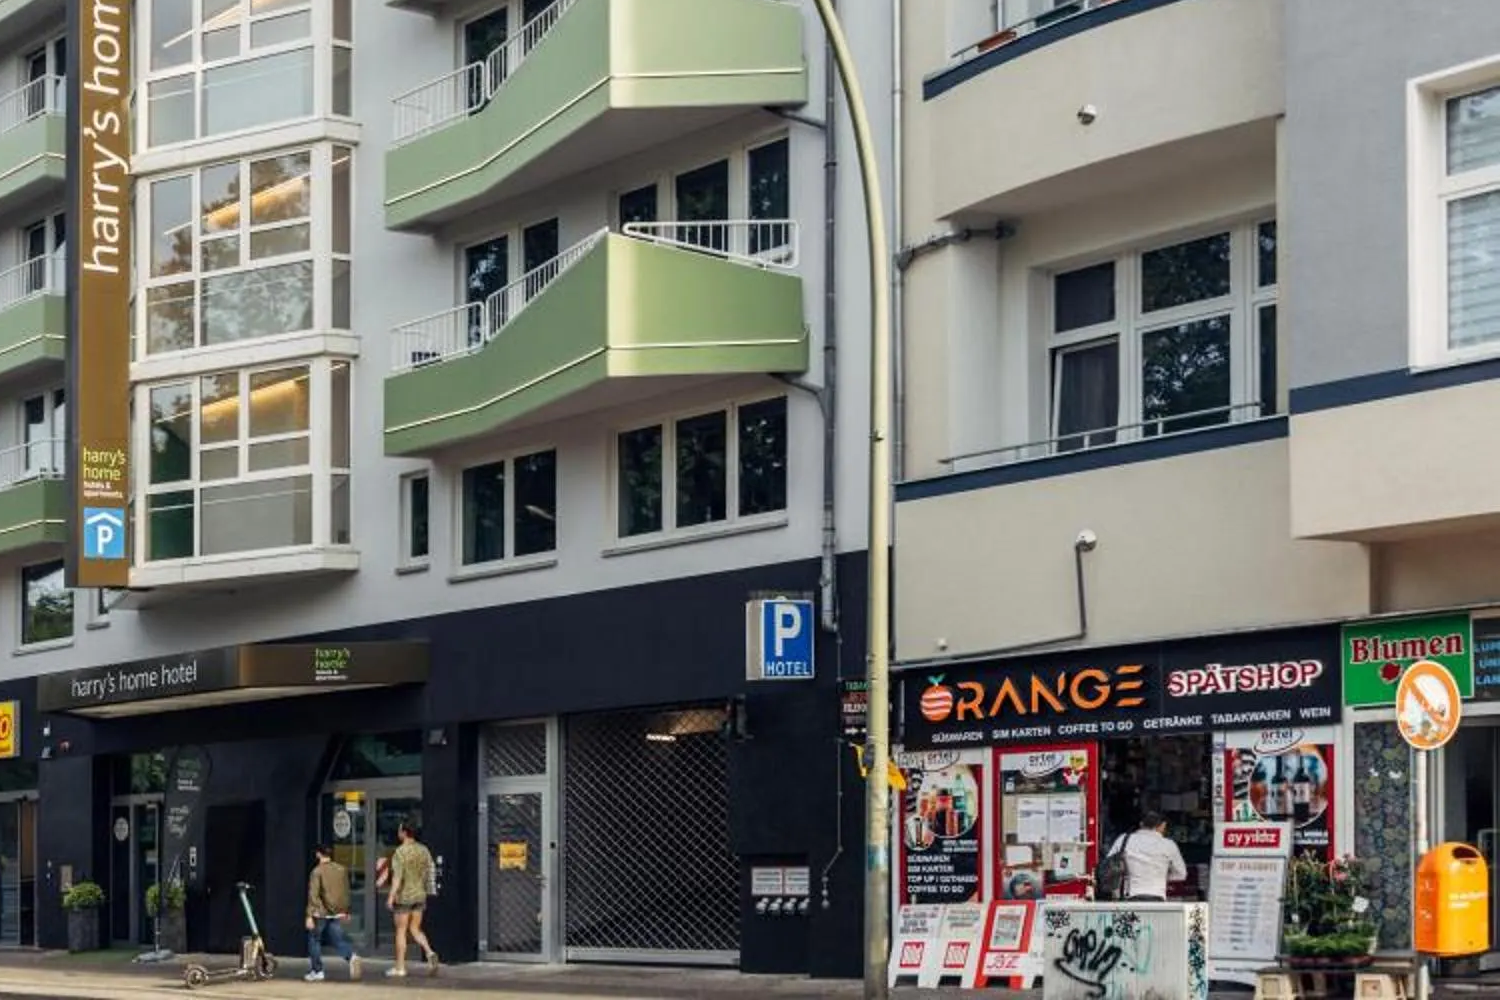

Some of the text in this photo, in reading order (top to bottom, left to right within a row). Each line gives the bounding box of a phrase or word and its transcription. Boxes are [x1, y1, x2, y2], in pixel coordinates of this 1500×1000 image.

[83, 109, 129, 274] harry's
[83, 446, 126, 467] harry's
[83, 463, 121, 481] home
[97, 525, 113, 555] P
[774, 603, 802, 657] P
[1350, 633, 1465, 664] Blumen
[71, 659, 197, 701] harry's home hotel
[766, 661, 810, 675] HOTEL
[1167, 659, 1323, 697] SPÄTSHOP
[992, 728, 1010, 740] SIM
[1011, 726, 1051, 739] KARTEN
[1058, 721, 1099, 735] COFFEE
[1101, 721, 1115, 733] TO
[1117, 720, 1134, 732] GO
[1143, 714, 1203, 730] GETRÄNKE
[1211, 708, 1291, 726] TABAKWAREN
[1300, 706, 1332, 720] WEIN
